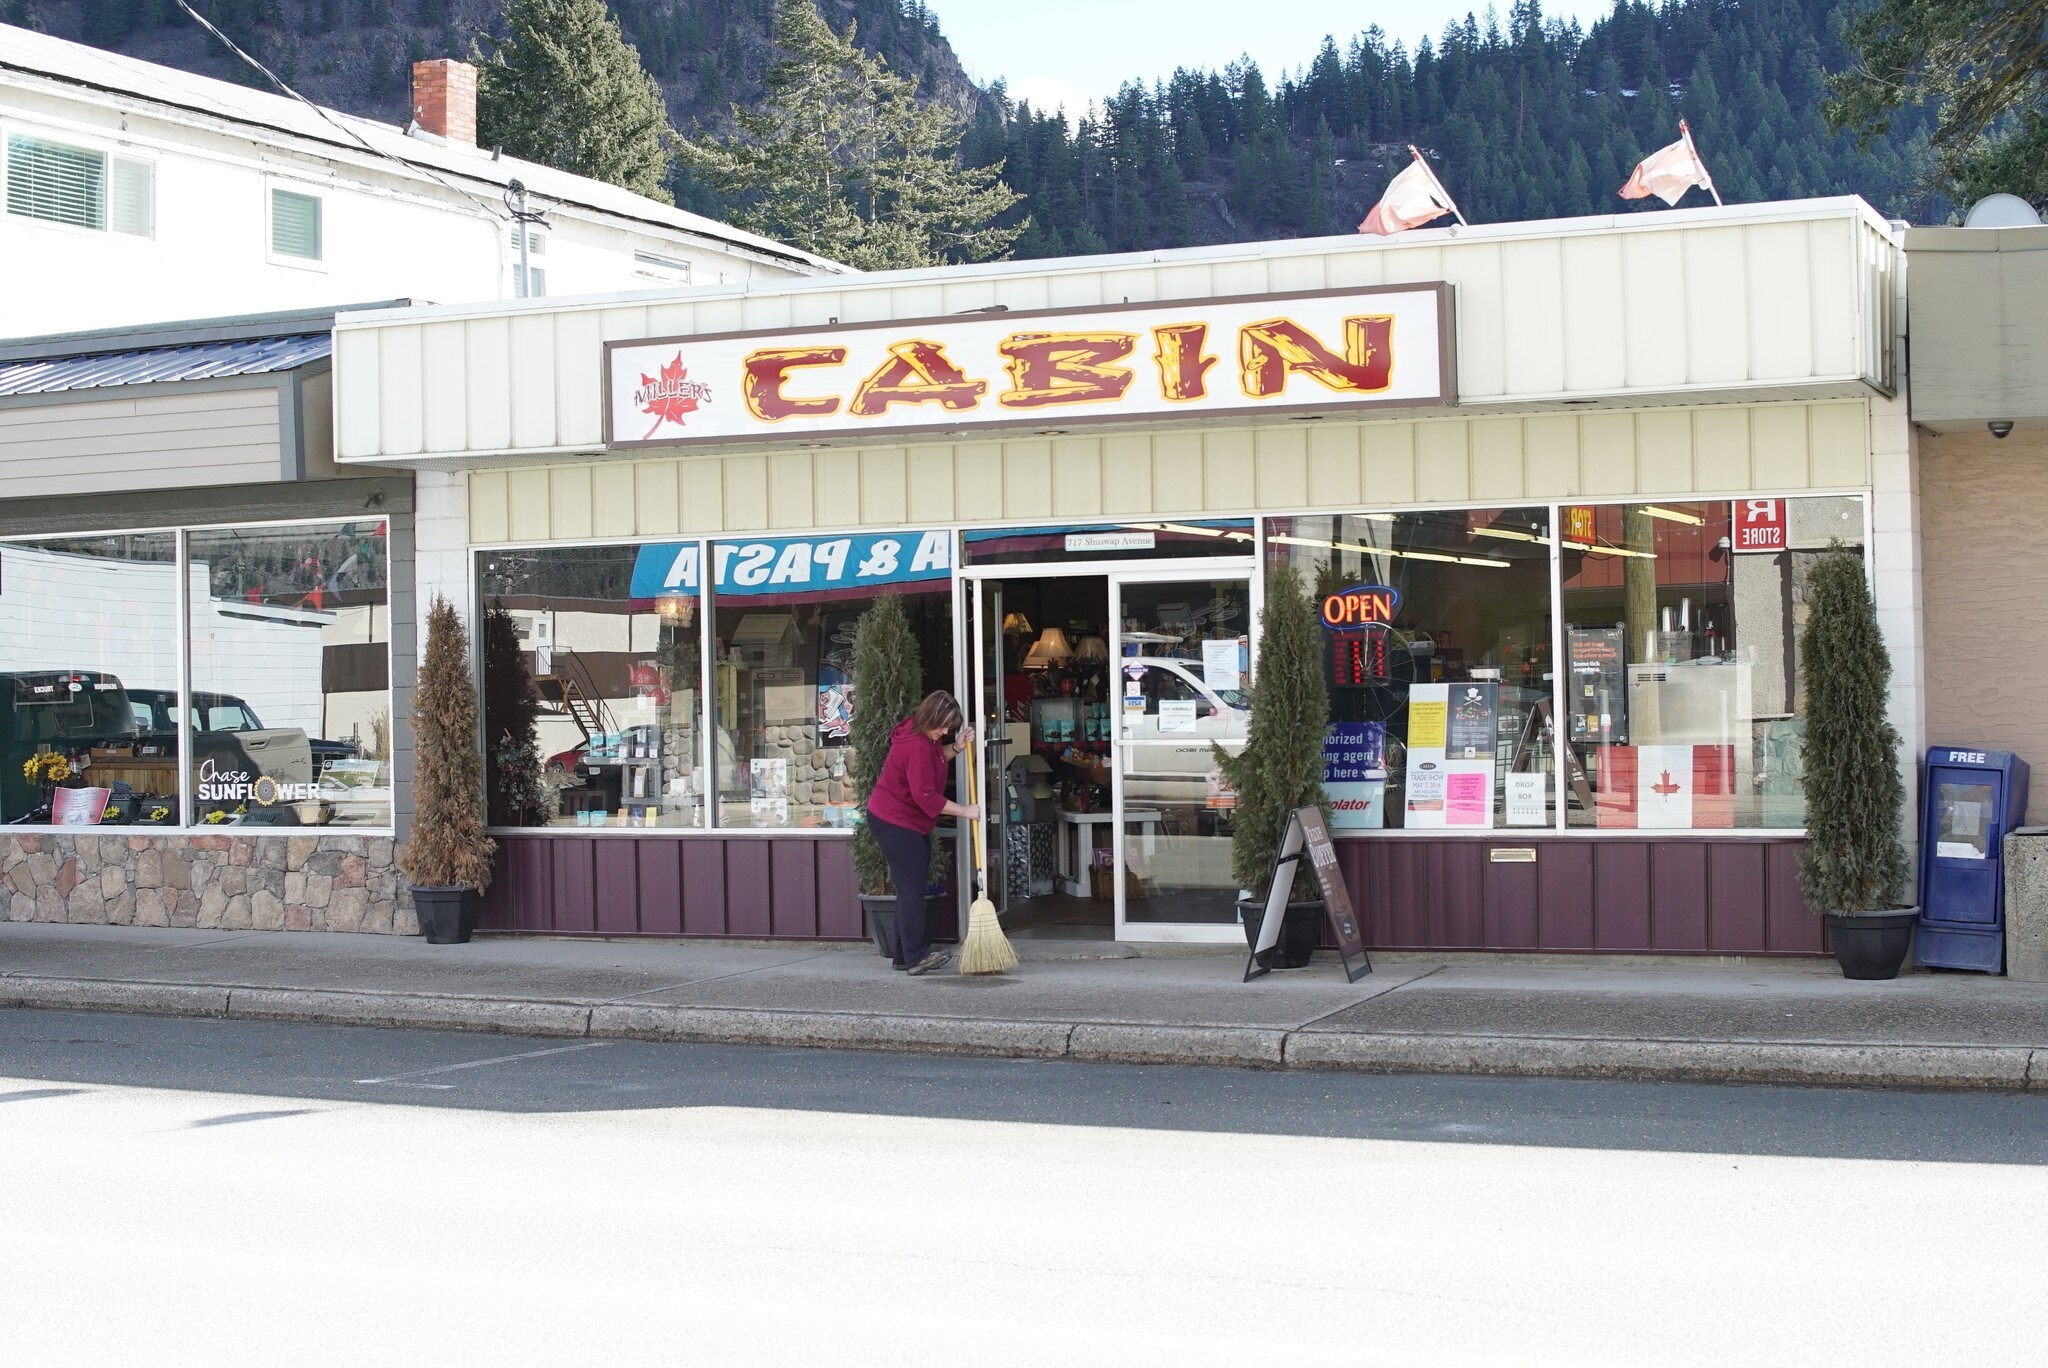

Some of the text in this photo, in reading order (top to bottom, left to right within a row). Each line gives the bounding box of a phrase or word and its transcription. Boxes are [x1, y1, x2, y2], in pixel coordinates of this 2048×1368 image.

[741, 313, 1395, 421] CABIN
[1067, 536, 1152, 547] 717 Shuswap Avenue
[1324, 593, 1391, 624] OPEN
[1322, 732, 1363, 745] horized
[1343, 751, 1374, 763] agent
[1949, 751, 1985, 763] FREE
[200, 759, 250, 783] Chase
[1333, 767, 1358, 778] here
[1330, 799, 1371, 810] olator
